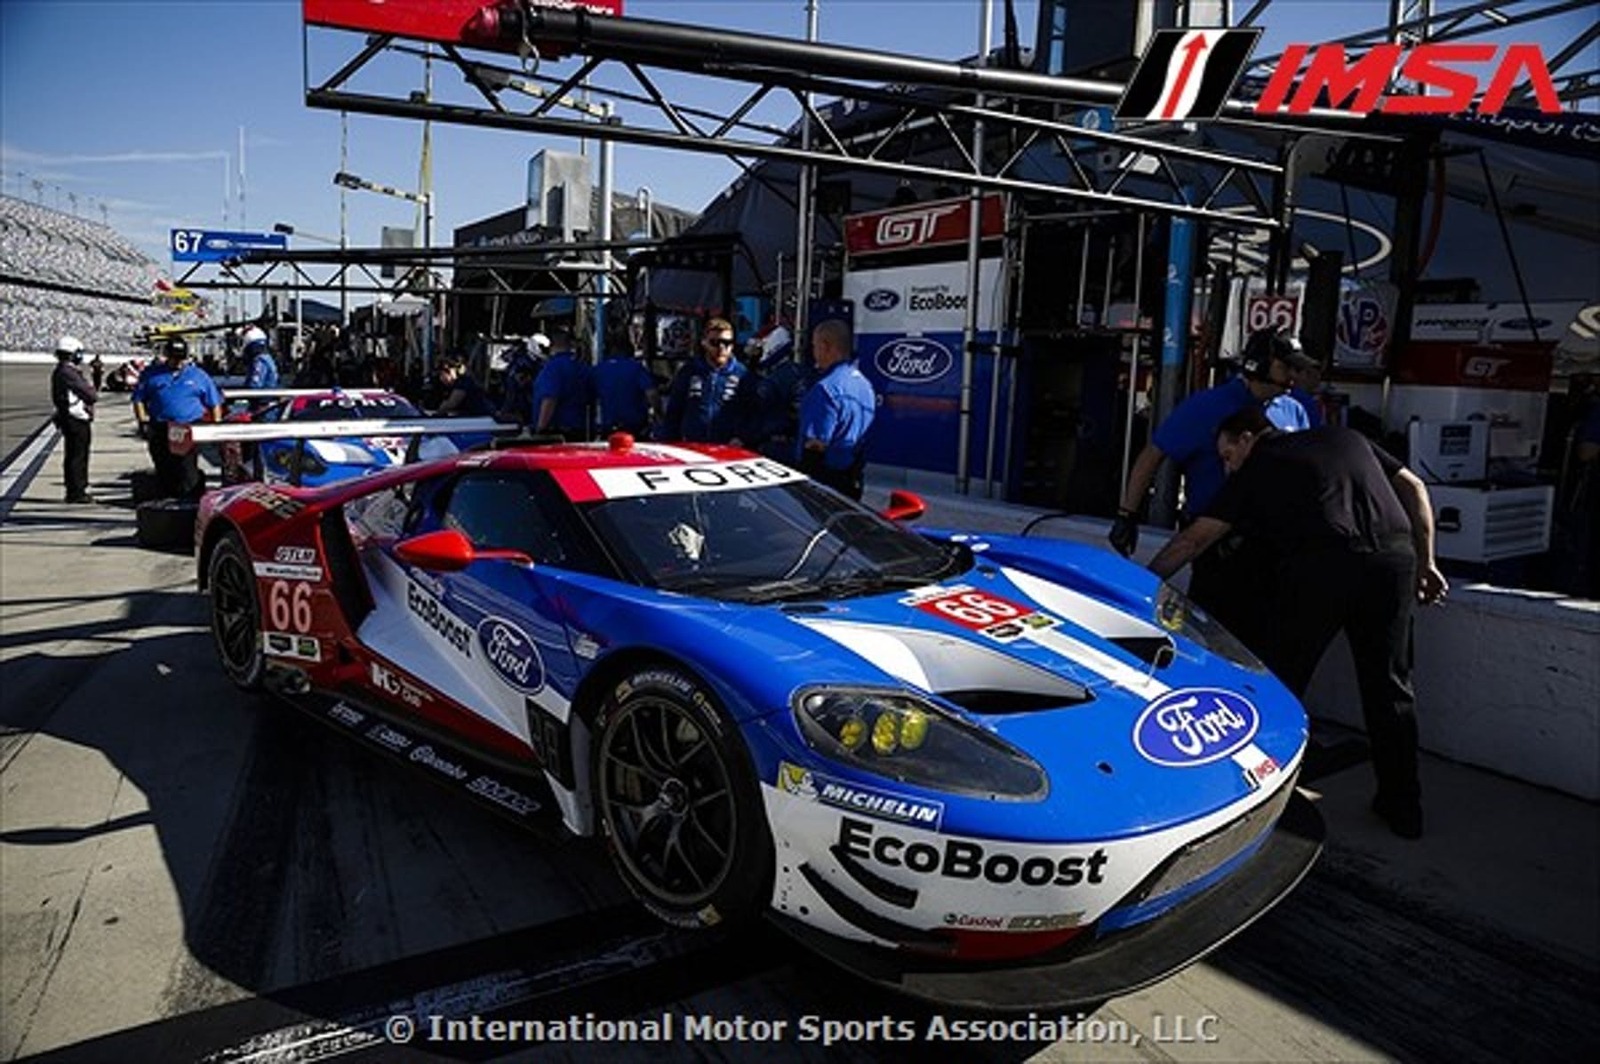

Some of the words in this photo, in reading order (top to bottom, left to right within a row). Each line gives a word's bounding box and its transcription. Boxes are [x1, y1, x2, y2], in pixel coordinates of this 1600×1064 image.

[174, 231, 203, 253] 67
[876, 204, 961, 245] GT
[1250, 300, 1293, 333] 66
[887, 342, 937, 374] Ford
[319, 397, 397, 408] FORD
[636, 461, 791, 491] FORD
[269, 580, 312, 633] 66
[407, 582, 473, 658] EcoBoost
[935, 593, 1020, 624] 66
[487, 623, 532, 684] Ford
[1156, 696, 1246, 756] Ford
[821, 783, 938, 822] MICHELIN
[839, 816, 1108, 886] EcoBoost
[956, 914, 1003, 928] Castrol
